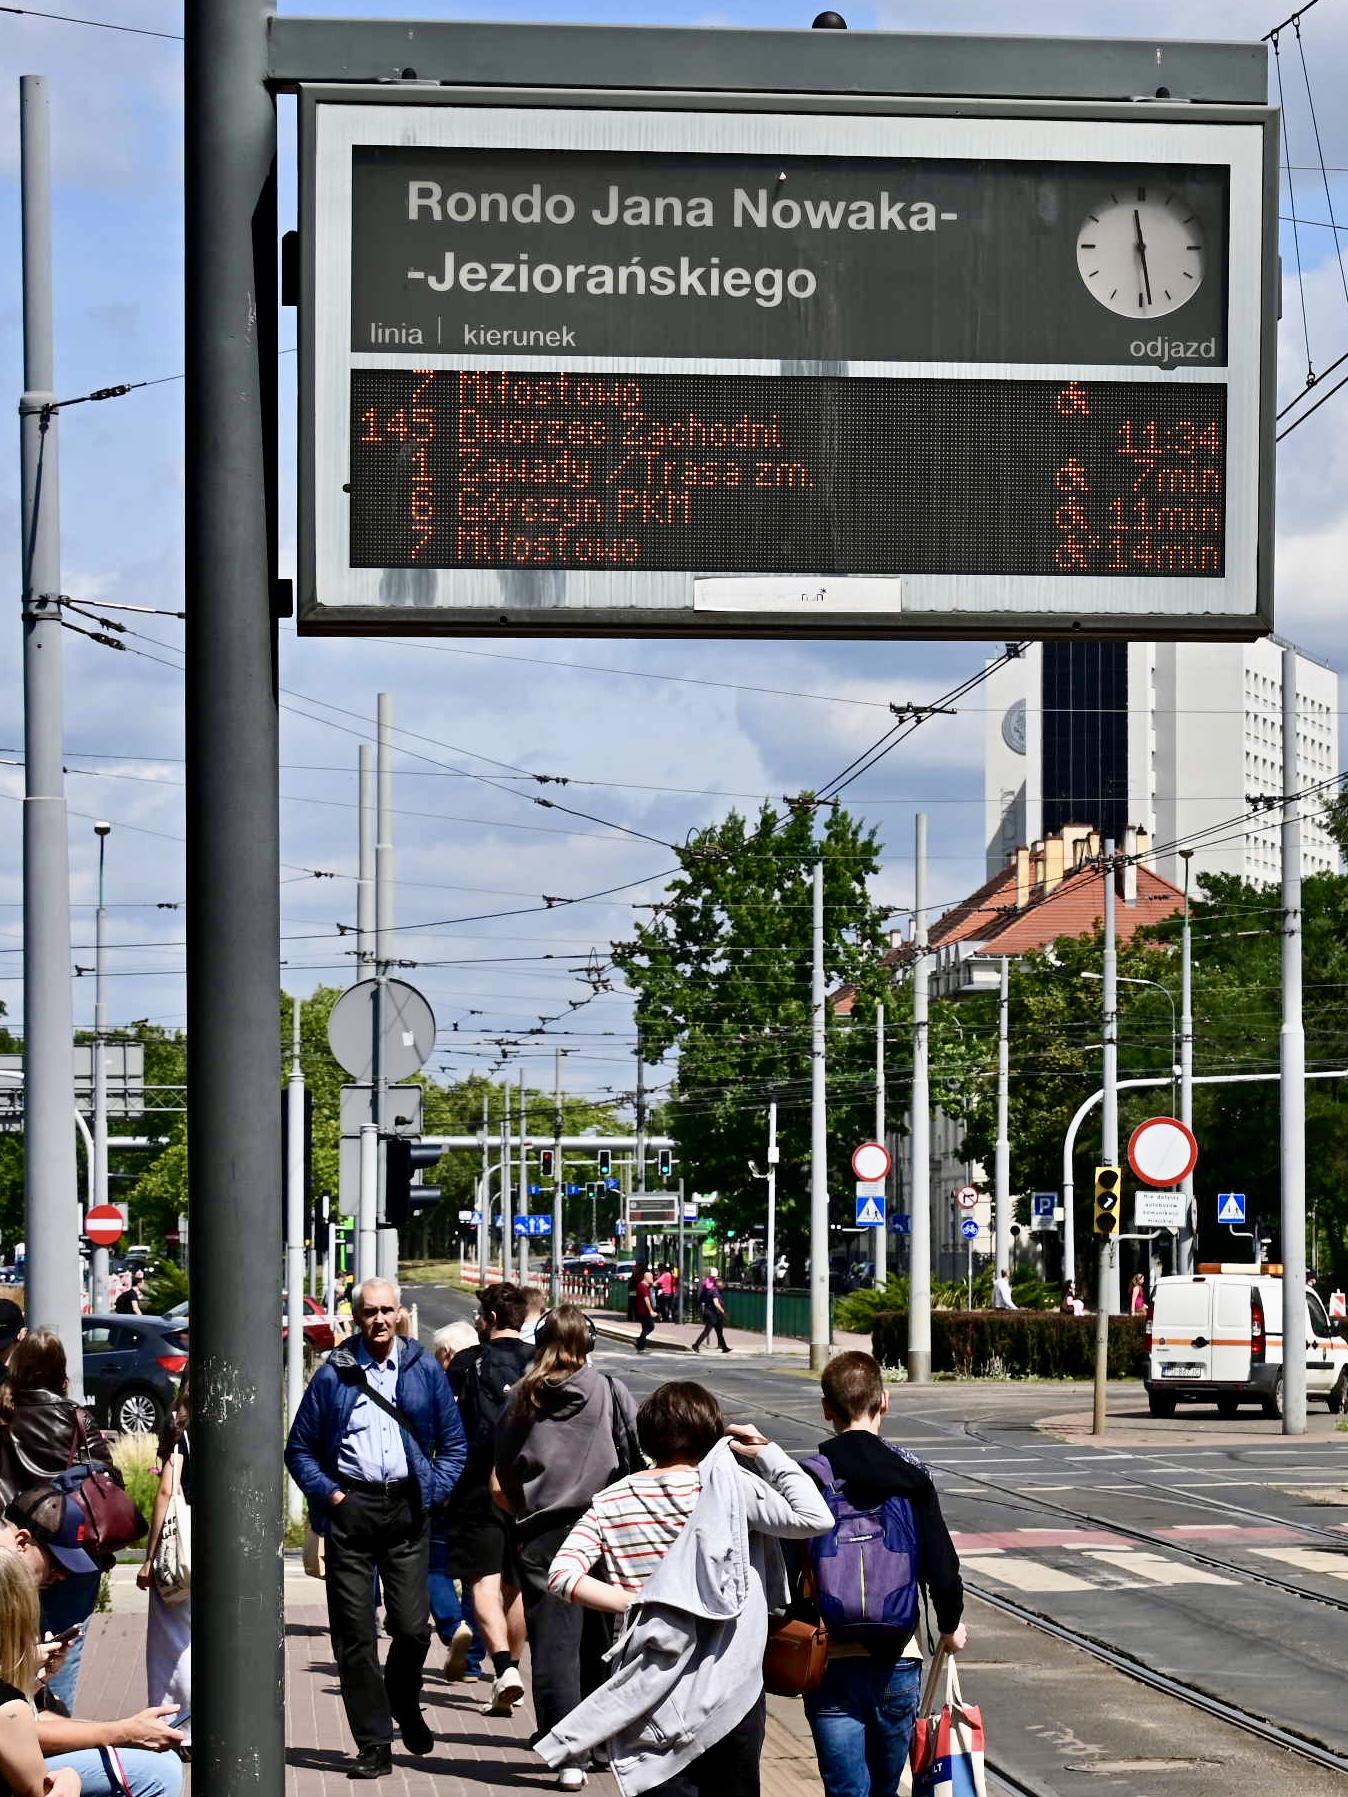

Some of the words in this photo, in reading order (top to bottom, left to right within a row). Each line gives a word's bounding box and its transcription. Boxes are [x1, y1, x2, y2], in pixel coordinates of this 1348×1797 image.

[408, 181, 576, 225] Rondo
[591, 185, 715, 228] Jana
[733, 188, 959, 232] Nowaka-
[407, 251, 818, 308] -Jeziorańskiego
[370, 322, 425, 345] linia
[464, 323, 577, 347] kierunek
[1129, 336, 1216, 363] odjazd
[412, 370, 435, 402] 7
[458, 371, 643, 406] Miłostowo
[359, 407, 436, 443] 145
[457, 409, 608, 445] Dworzec
[621, 412, 783, 449] Zachodni
[1117, 419, 1220, 455] 11:34
[411, 447, 434, 481] 1
[457, 448, 595, 489] Zawady
[1132, 458, 1221, 492] 7min
[411, 486, 435, 521] 6
[457, 487, 603, 527] Górczyn
[617, 490, 692, 524] PKM
[1108, 496, 1220, 532] 11min
[411, 526, 435, 560] 7
[457, 527, 643, 563] Miłostowo
[1108, 535, 1220, 570] 14min
